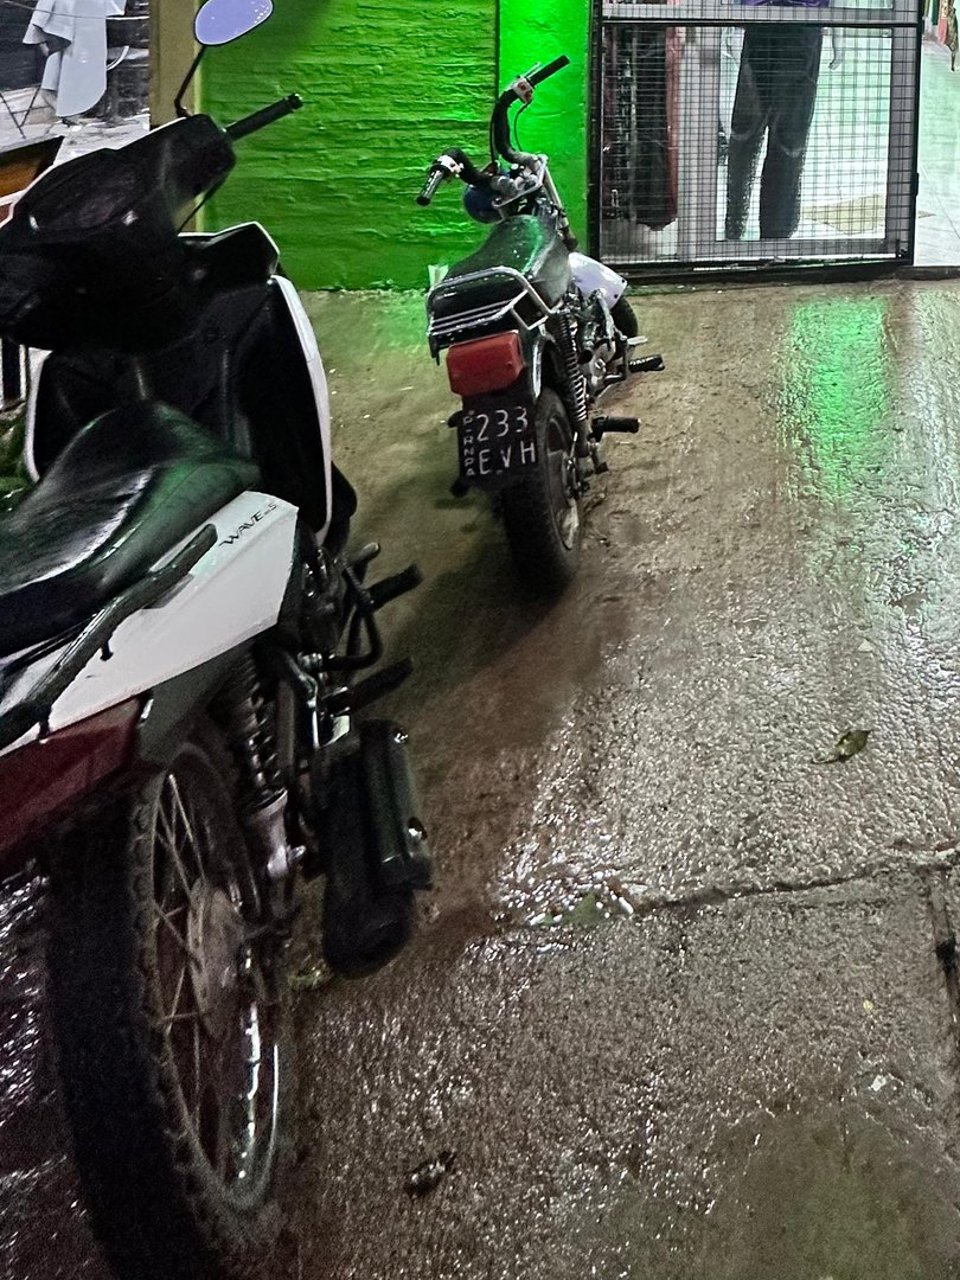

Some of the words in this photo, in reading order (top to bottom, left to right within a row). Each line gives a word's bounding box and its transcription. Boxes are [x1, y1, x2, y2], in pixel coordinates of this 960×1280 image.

[477, 406, 528, 442] 233
[479, 441, 536, 475] EVH
[218, 511, 263, 546] WAVE
